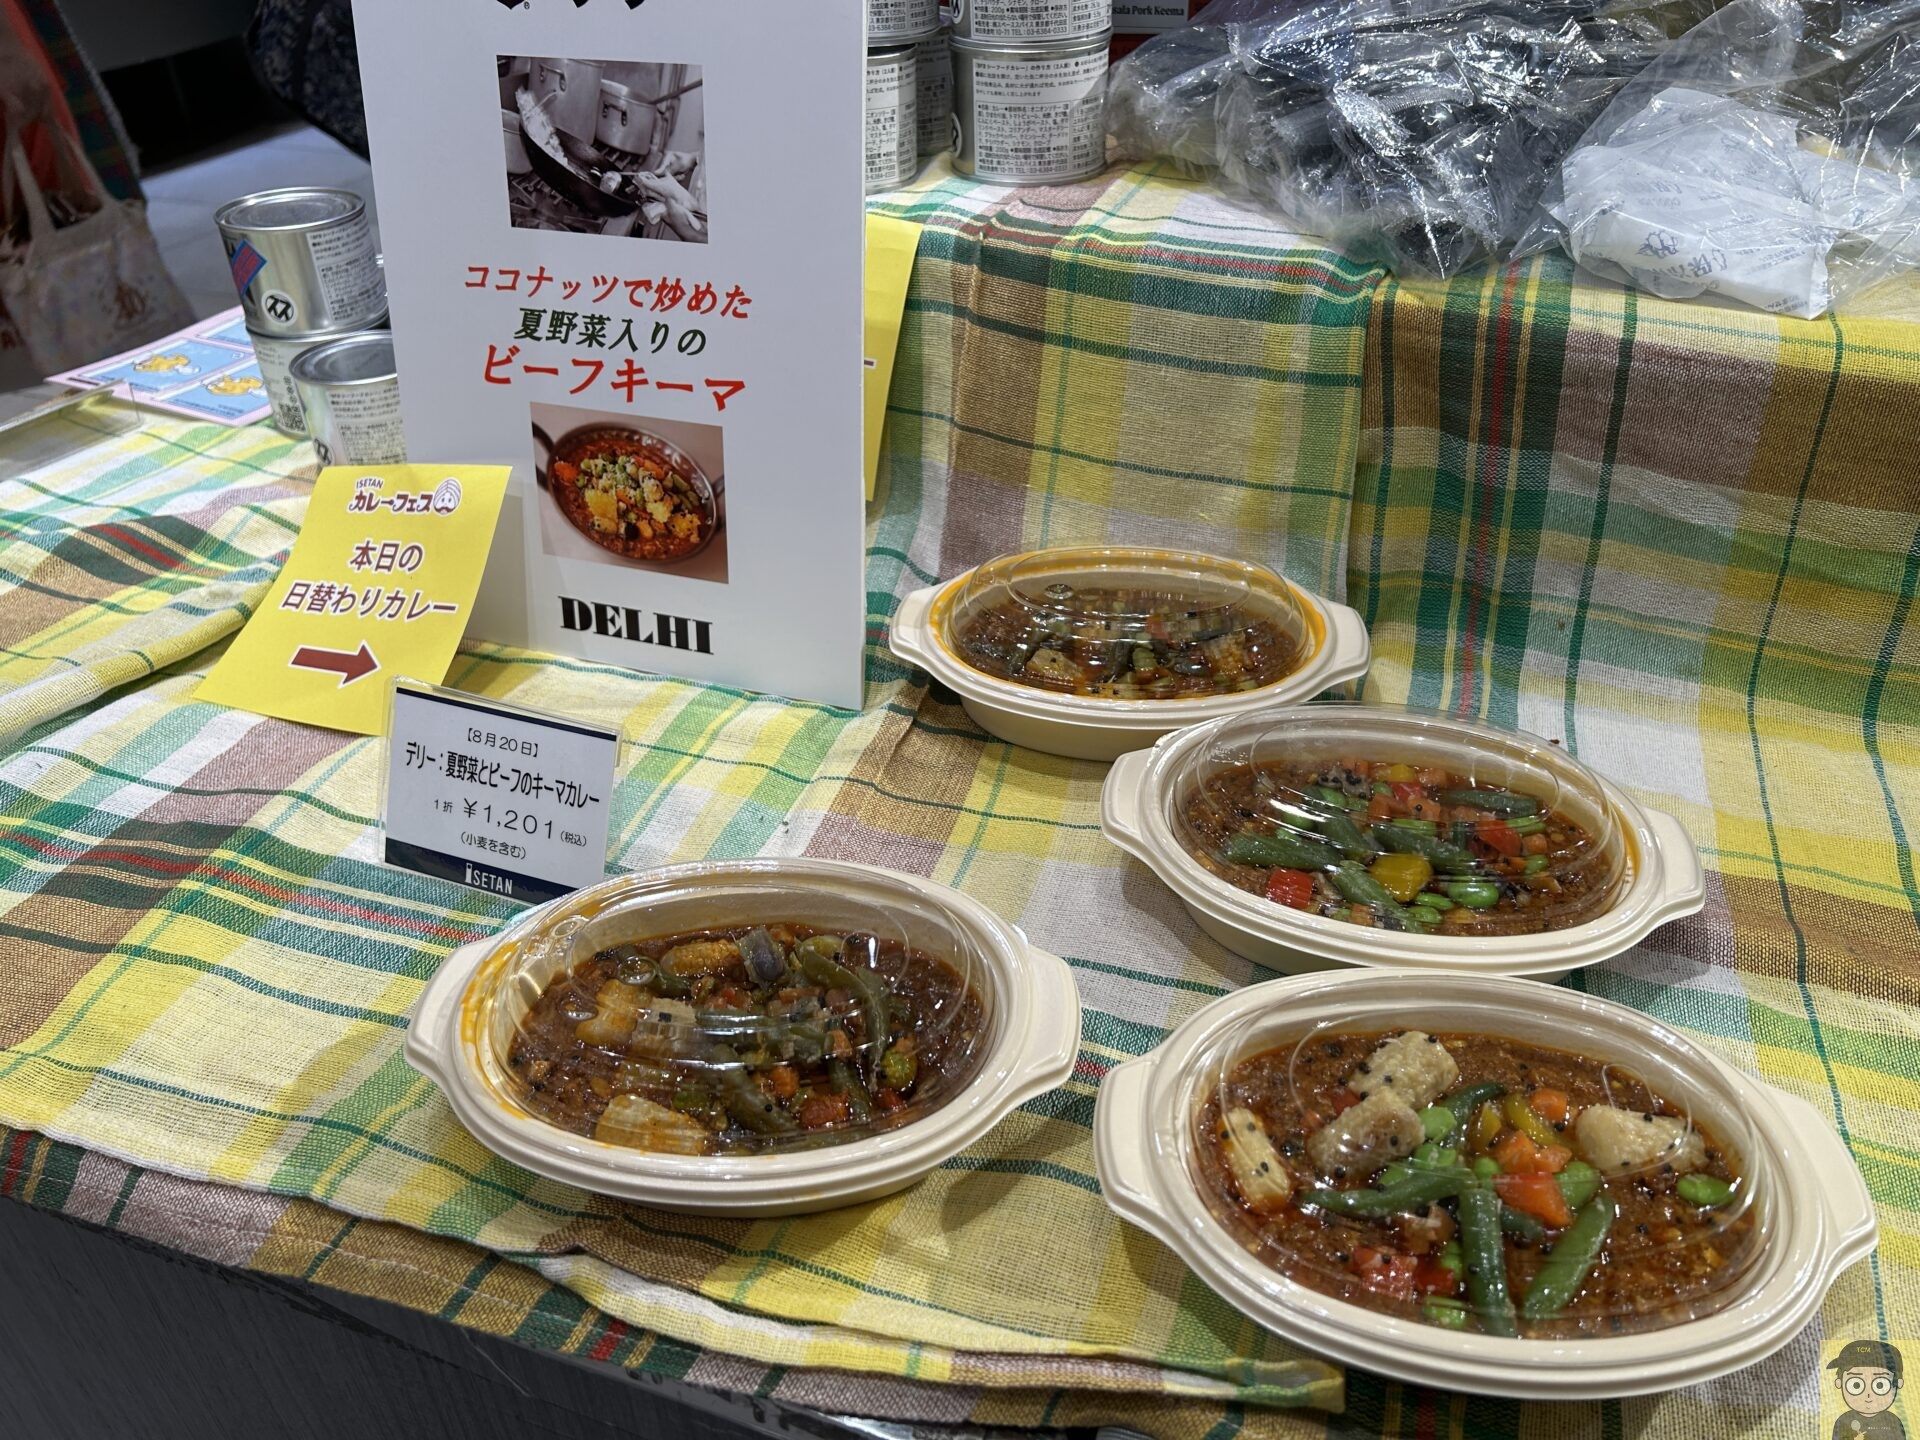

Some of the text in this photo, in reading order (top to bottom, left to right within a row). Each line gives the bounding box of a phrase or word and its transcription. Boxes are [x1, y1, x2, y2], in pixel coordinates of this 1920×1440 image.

[1131, 5, 1153, 15] Pork
[1154, 5, 1184, 16] Keema
[464, 266, 753, 319] ココナッツで炒めた
[513, 307, 707, 356] 夏野菜入りの
[484, 344, 746, 412] ビーフキーマ
[349, 491, 433, 512] カレーフェス
[355, 478, 384, 489] ISETAN
[350, 540, 424, 572] 本日の
[281, 582, 457, 620] 日替わりカレー
[557, 595, 715, 655] DELHI
